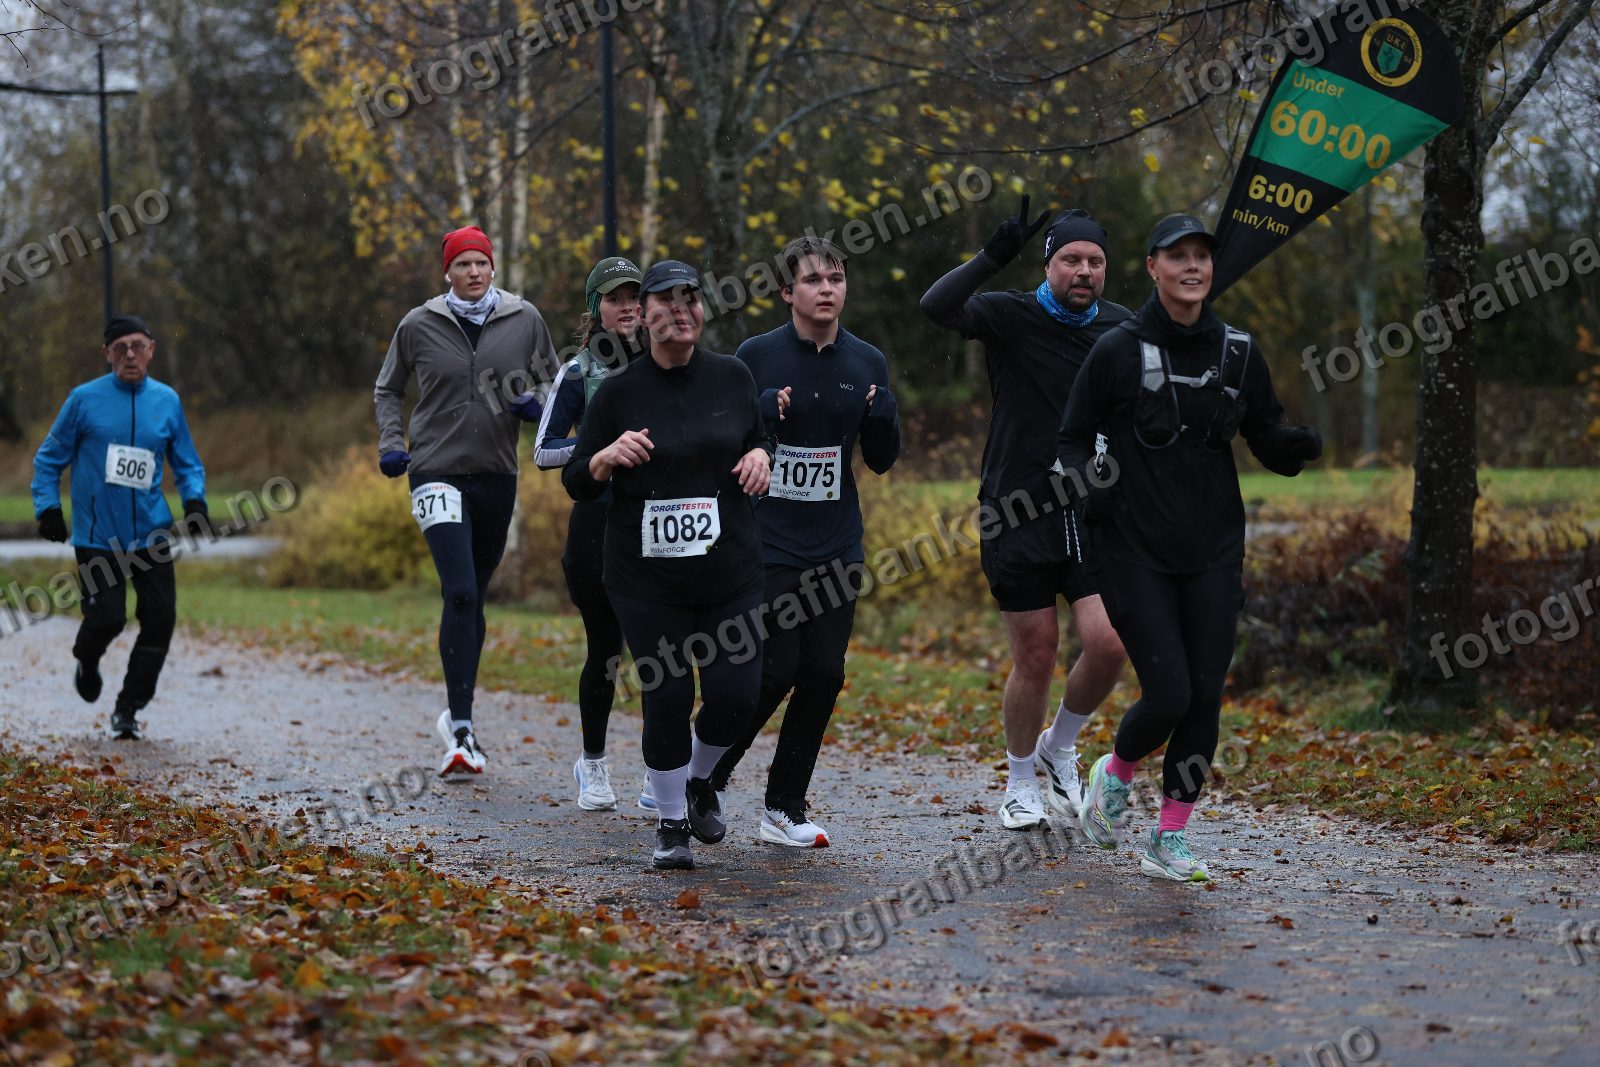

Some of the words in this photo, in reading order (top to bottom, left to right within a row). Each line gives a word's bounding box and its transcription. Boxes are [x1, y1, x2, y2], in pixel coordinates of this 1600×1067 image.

[1292, 72, 1345, 98] Under
[1270, 101, 1391, 169] 60:00
[1249, 174, 1313, 214] 6:00
[1232, 208, 1290, 236] min/km
[116, 457, 147, 480] 506
[780, 460, 835, 488] 1075
[418, 492, 447, 519] 371
[649, 512, 713, 544] 1082
